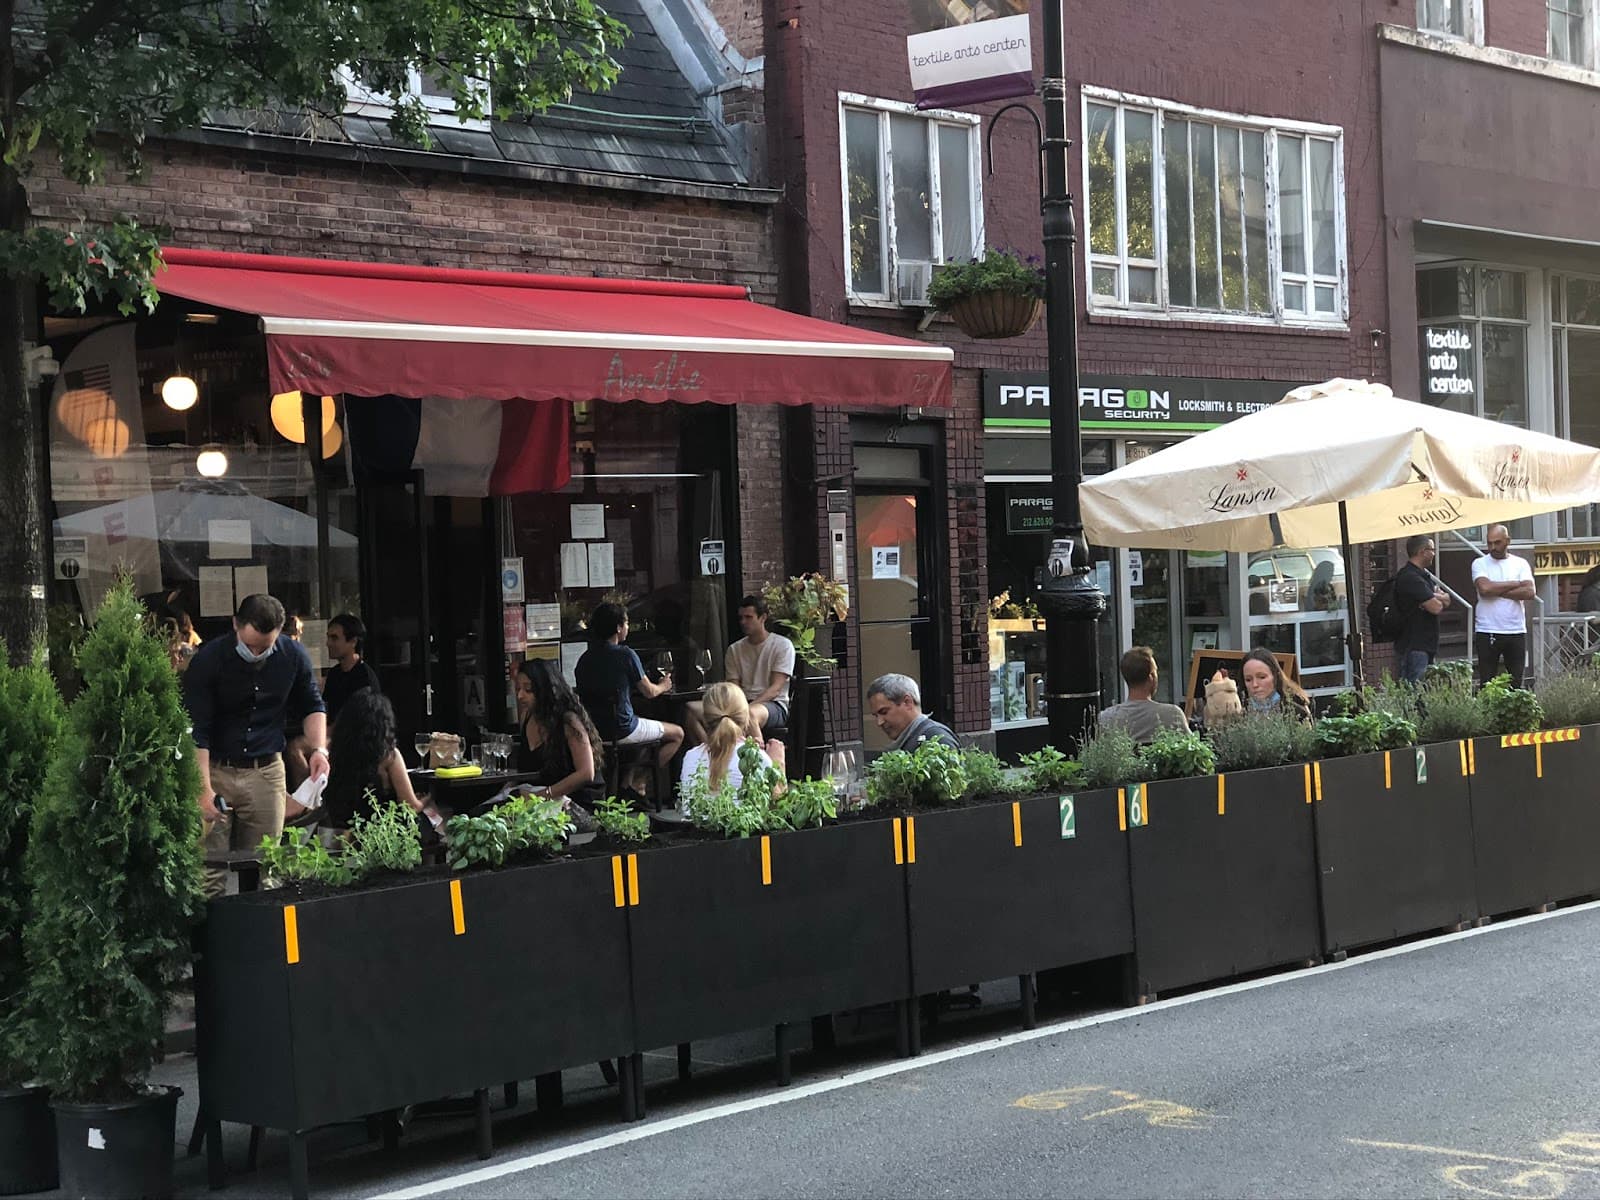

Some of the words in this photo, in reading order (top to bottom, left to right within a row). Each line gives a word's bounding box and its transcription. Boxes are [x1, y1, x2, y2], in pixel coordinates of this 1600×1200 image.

[912, 51, 953, 67] textile
[954, 44, 980, 60] arts
[983, 37, 1026, 54] center
[1426, 329, 1471, 349] textile
[1430, 351, 1457, 370] arts
[1431, 374, 1473, 393] center
[1000, 385, 1170, 409] PAAGON
[1178, 400, 1225, 412] LOCKSMITH
[1226, 401, 1233, 412] &
[1236, 402, 1273, 413] ELECTRO
[1104, 409, 1170, 419] SECURITY
[1010, 498, 1054, 507] PARAG
[1204, 483, 1280, 513] Lanson
[1416, 750, 1427, 782] 2
[1131, 786, 1141, 825] 6
[1060, 798, 1075, 836] 2
